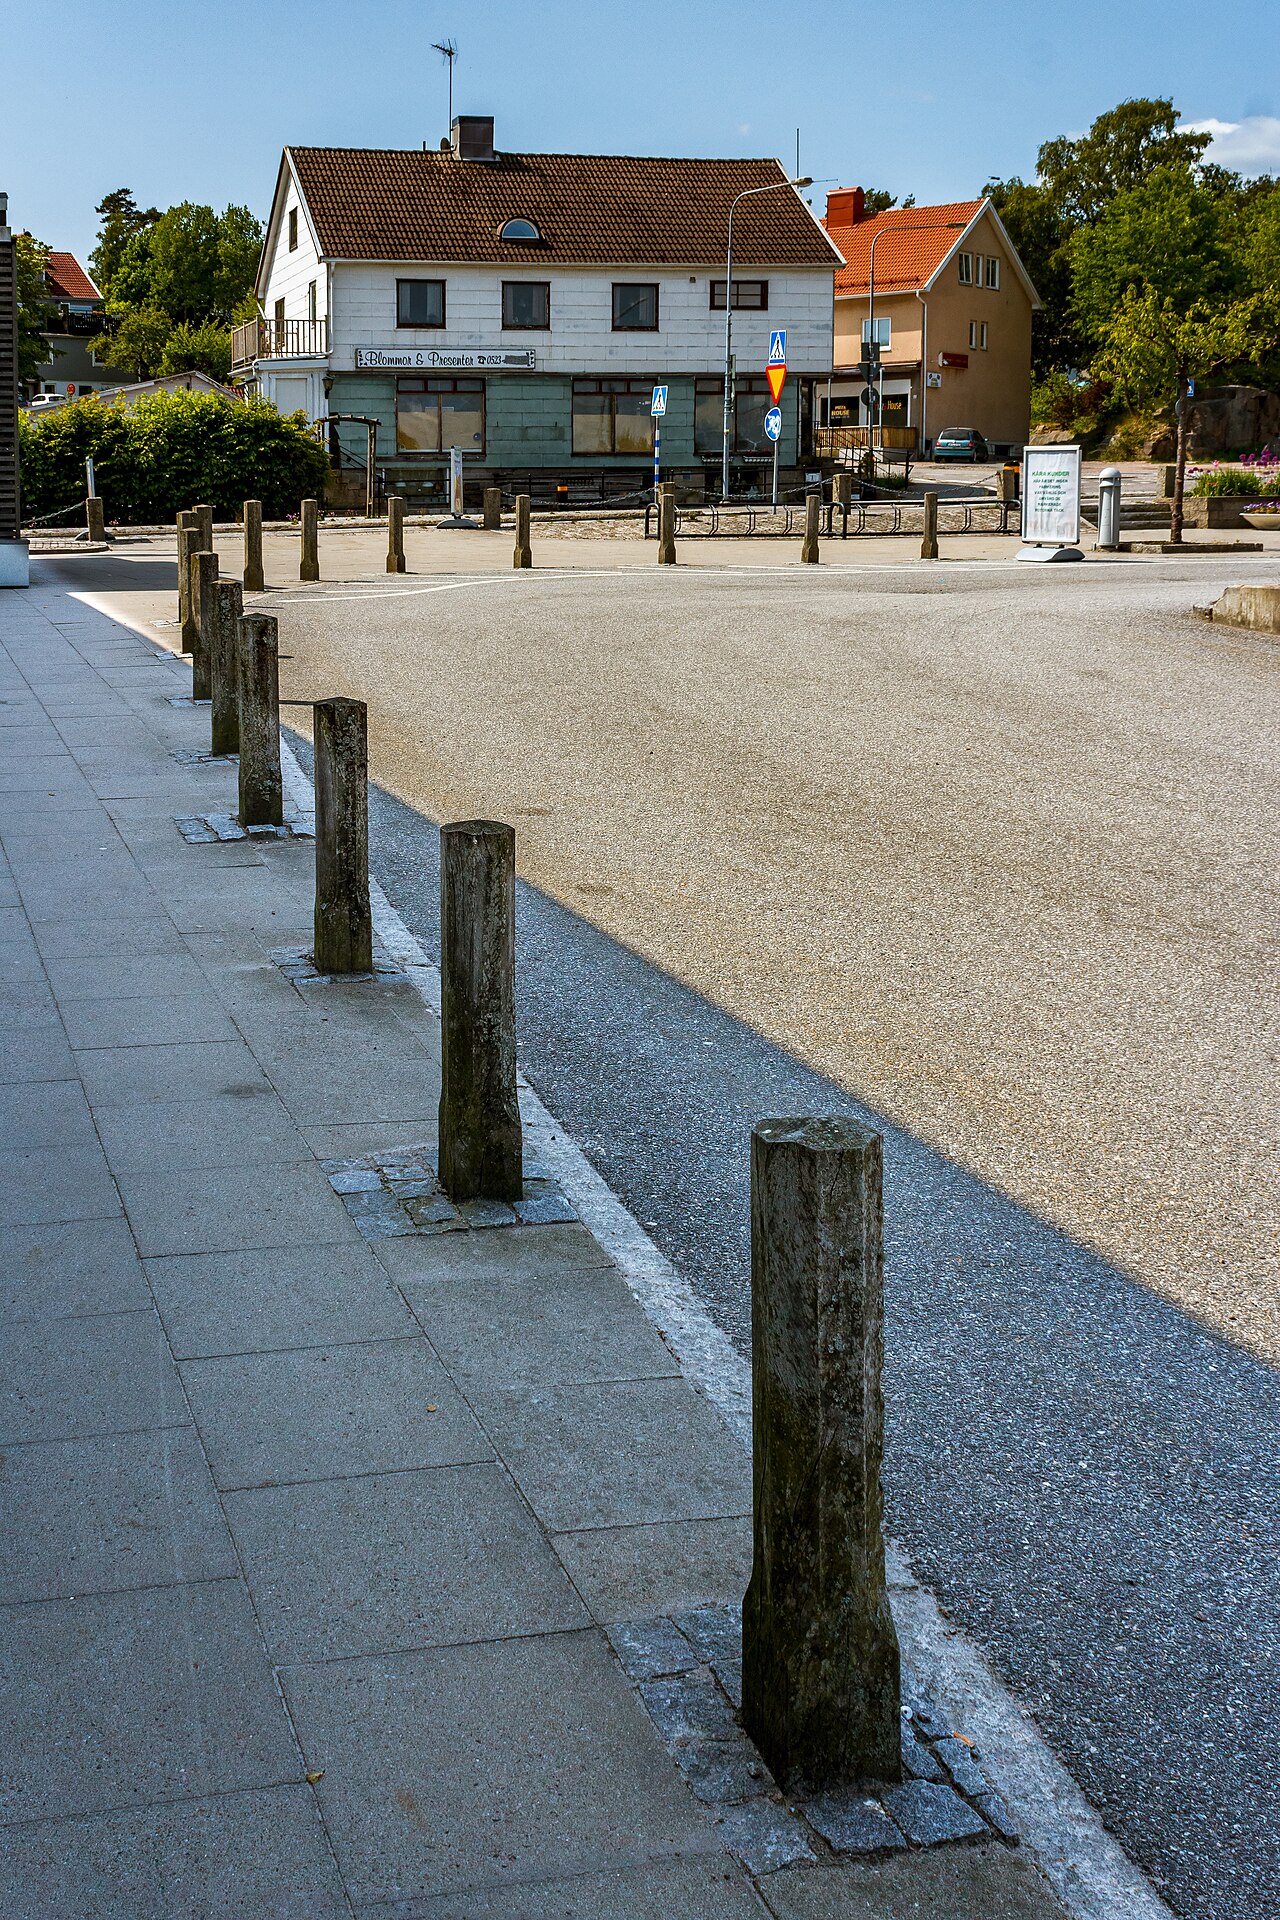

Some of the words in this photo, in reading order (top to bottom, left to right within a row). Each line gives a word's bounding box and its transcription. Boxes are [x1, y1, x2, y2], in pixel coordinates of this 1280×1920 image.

[365, 351, 411, 366] Blommor
[416, 353, 424, 365] &
[428, 351, 474, 366] Presenter
[887, 400, 902, 410] House
